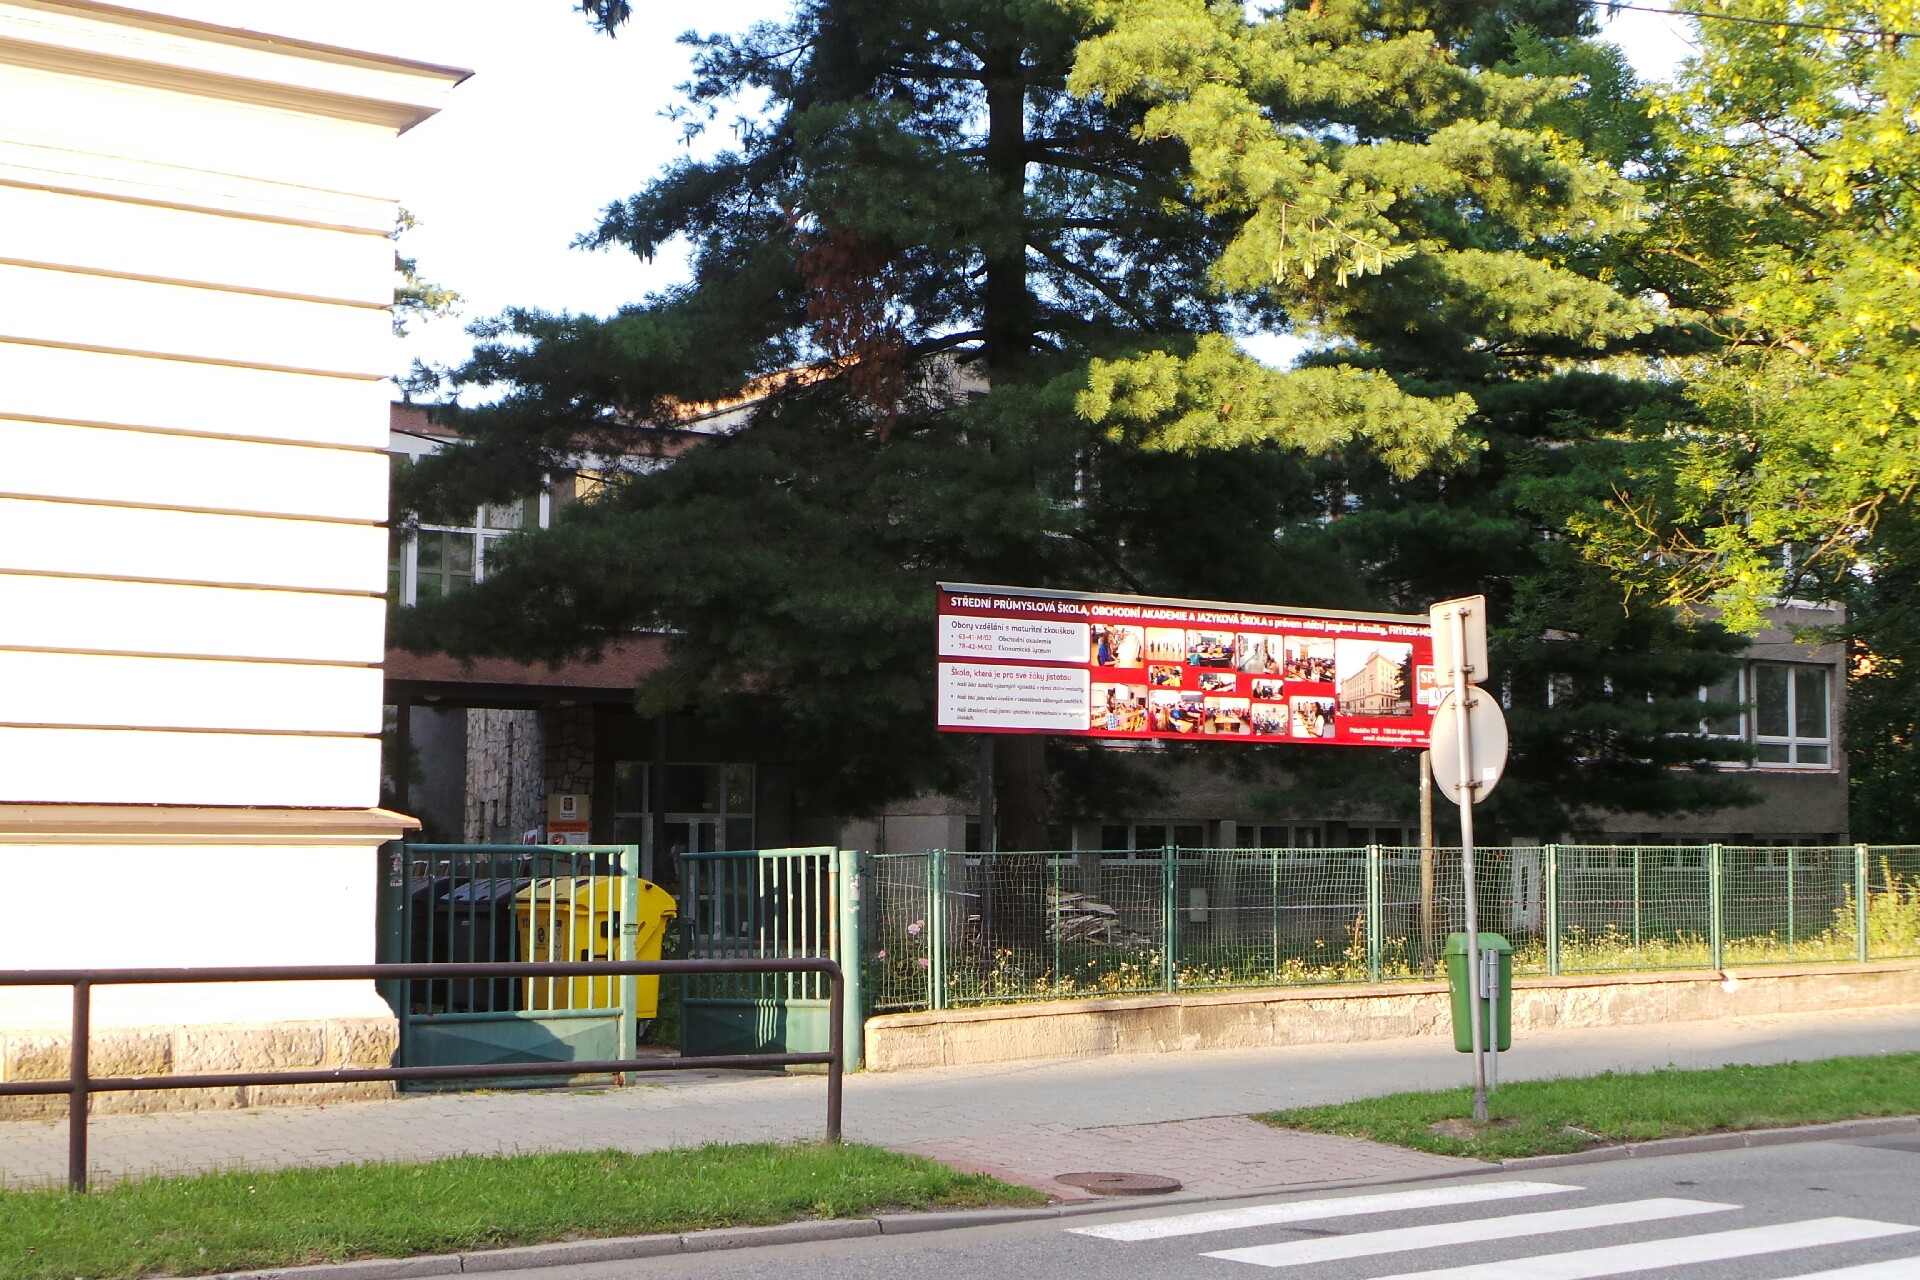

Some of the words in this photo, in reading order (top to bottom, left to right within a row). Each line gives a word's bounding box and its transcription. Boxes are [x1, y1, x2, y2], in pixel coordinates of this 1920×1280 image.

[951, 595, 991, 609] STŘEDNÍ
[993, 598, 1056, 613] PRŮMYSLOVÁ
[1058, 602, 1090, 616] ŠKOLA,
[1091, 605, 1141, 619] OBCHODNÍ
[1141, 609, 1187, 621] AKADEMIE
[1189, 613, 1196, 622] A
[1197, 612, 1239, 624] JAZYKOVÁ
[1240, 613, 1268, 626] ŠKOLA
[1389, 624, 1433, 637] FRÝDEK-MÍS
[951, 621, 973, 631] Obory
[975, 622, 1004, 632] vzdělání
[1044, 626, 1075, 635] zkouškou
[951, 667, 972, 678] Škola,
[974, 669, 993, 678] která
